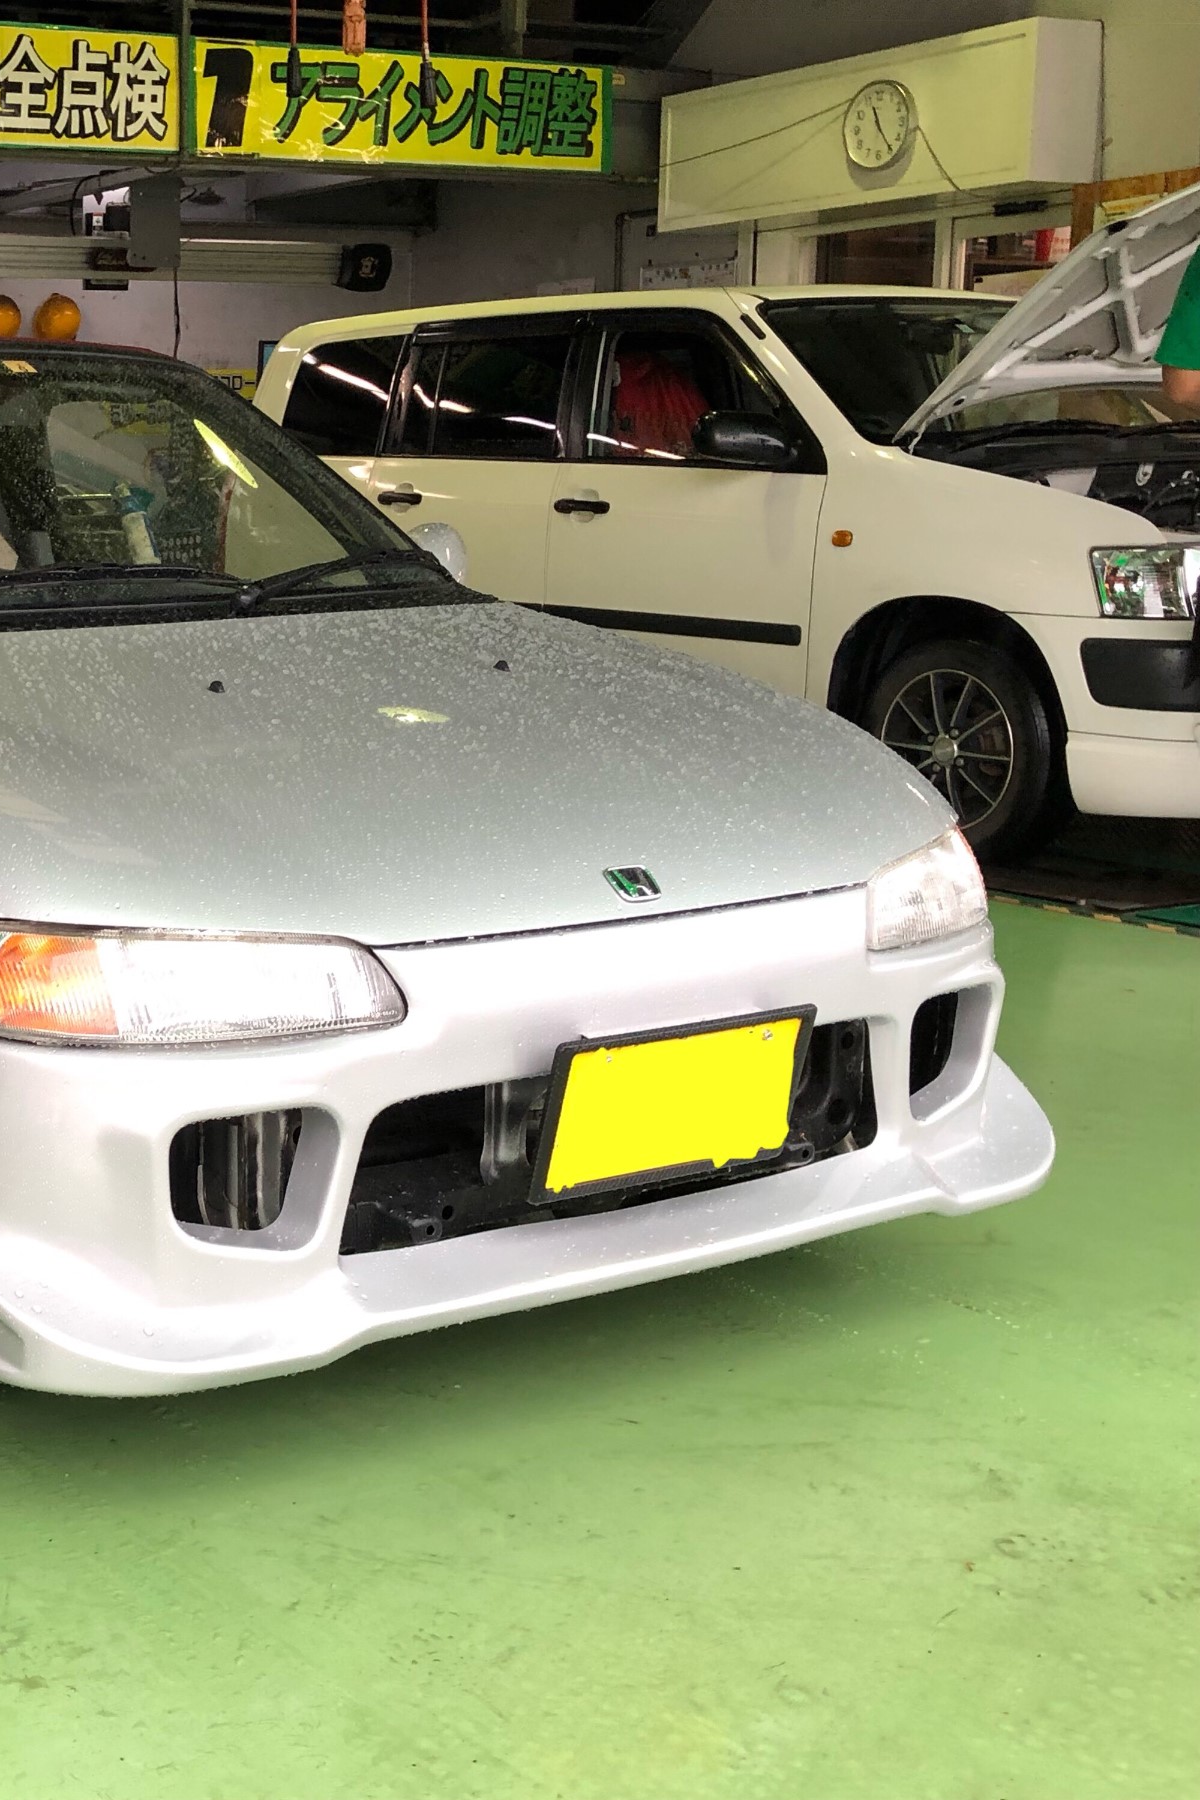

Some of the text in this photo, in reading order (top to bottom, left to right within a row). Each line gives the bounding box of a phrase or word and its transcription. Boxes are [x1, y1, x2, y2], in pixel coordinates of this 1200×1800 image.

[202, 48, 254, 148] 1
[271, 60, 598, 157] アライメント調整
